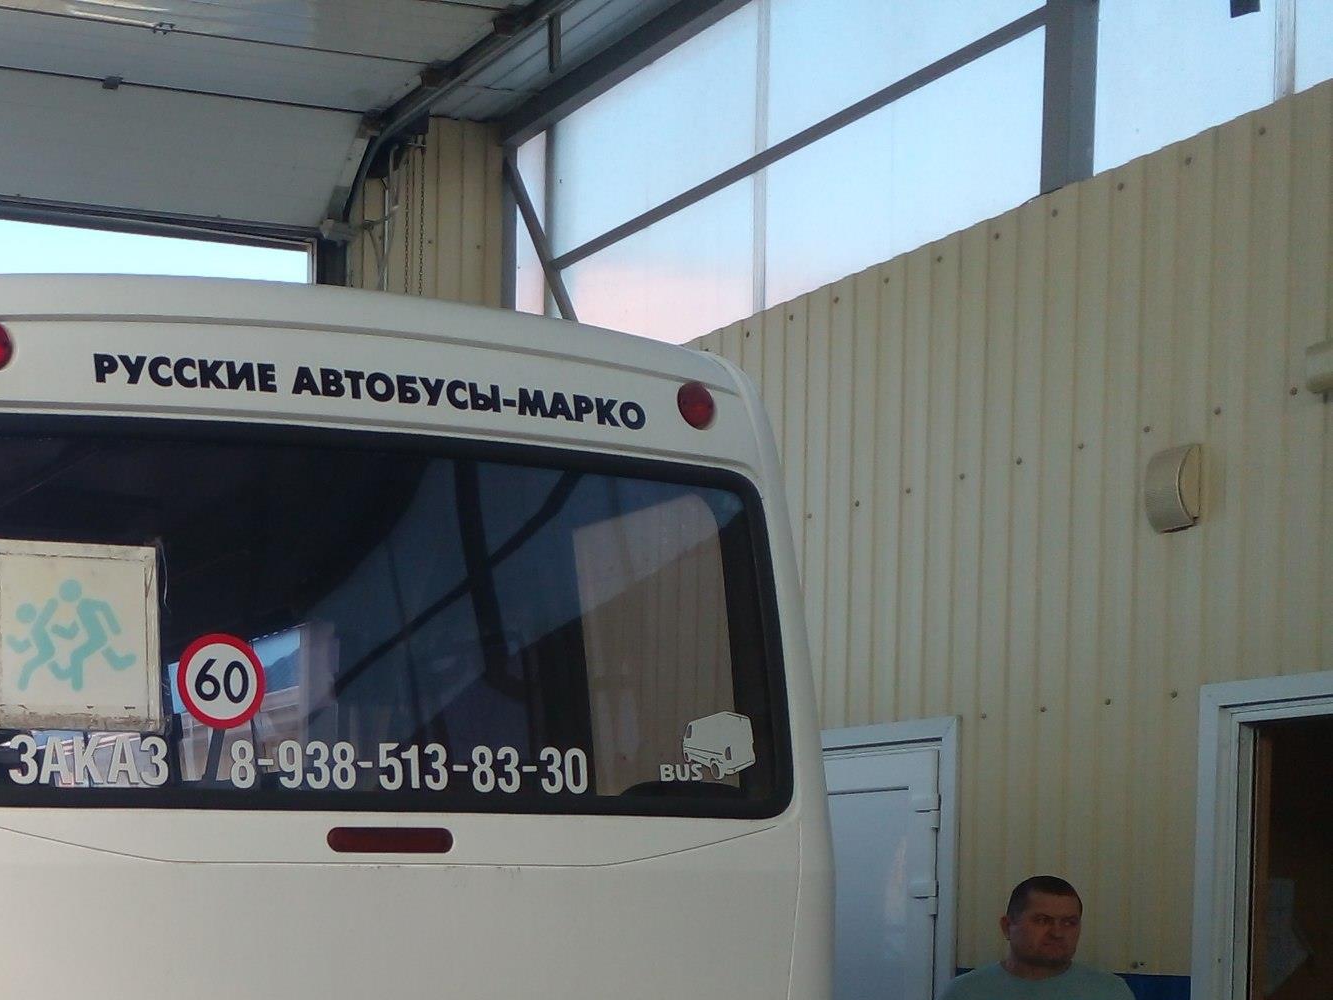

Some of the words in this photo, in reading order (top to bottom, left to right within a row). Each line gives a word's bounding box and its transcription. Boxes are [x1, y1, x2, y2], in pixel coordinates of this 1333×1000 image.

[93, 353, 277, 393] РУССКИЕ
[291, 366, 647, 431] АВТОБУСЫ-МАРКО
[194, 658, 250, 703] 60
[8, 735, 169, 787] ЗАКАЗ
[230, 738, 589, 795] 8-938-513-83-30
[660, 764, 703, 781] BUS
